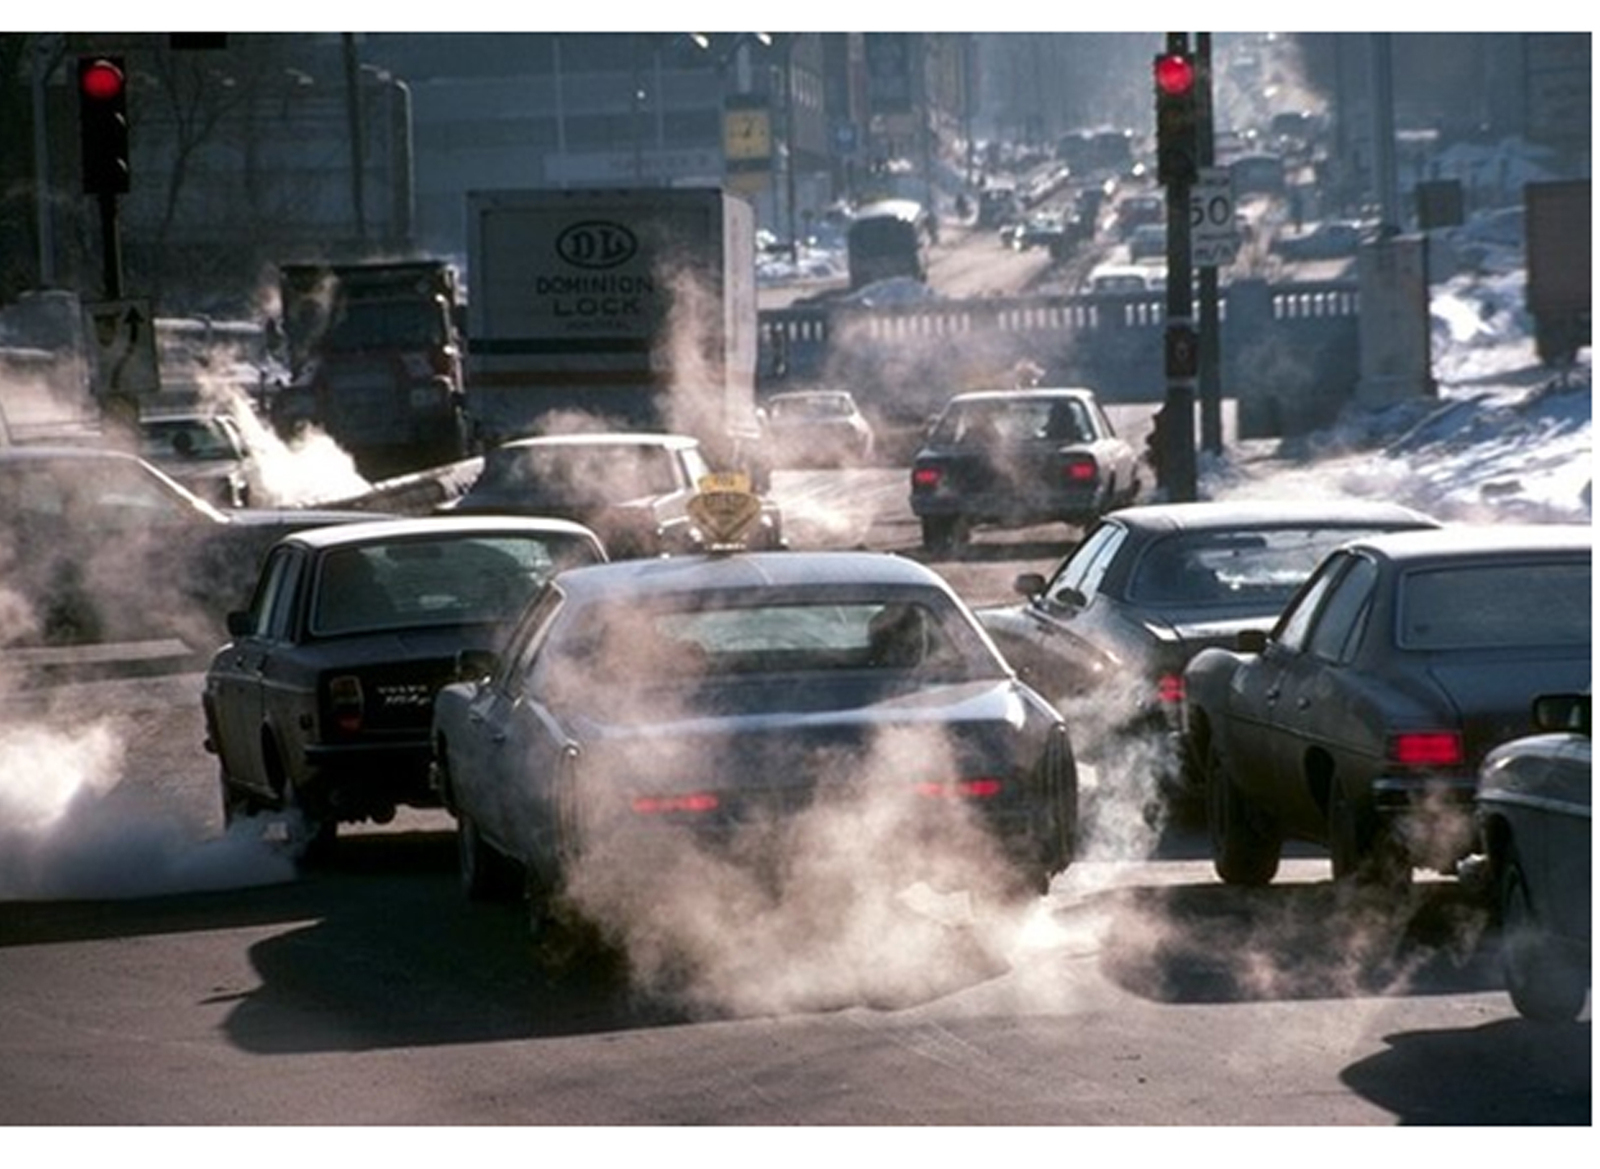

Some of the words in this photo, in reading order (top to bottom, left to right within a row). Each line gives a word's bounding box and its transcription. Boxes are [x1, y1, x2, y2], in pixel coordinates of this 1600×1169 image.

[1189, 195, 1229, 228] 50
[570, 229, 627, 260] DL
[536, 275, 653, 295] DOMINION
[553, 298, 641, 317] LOCK
